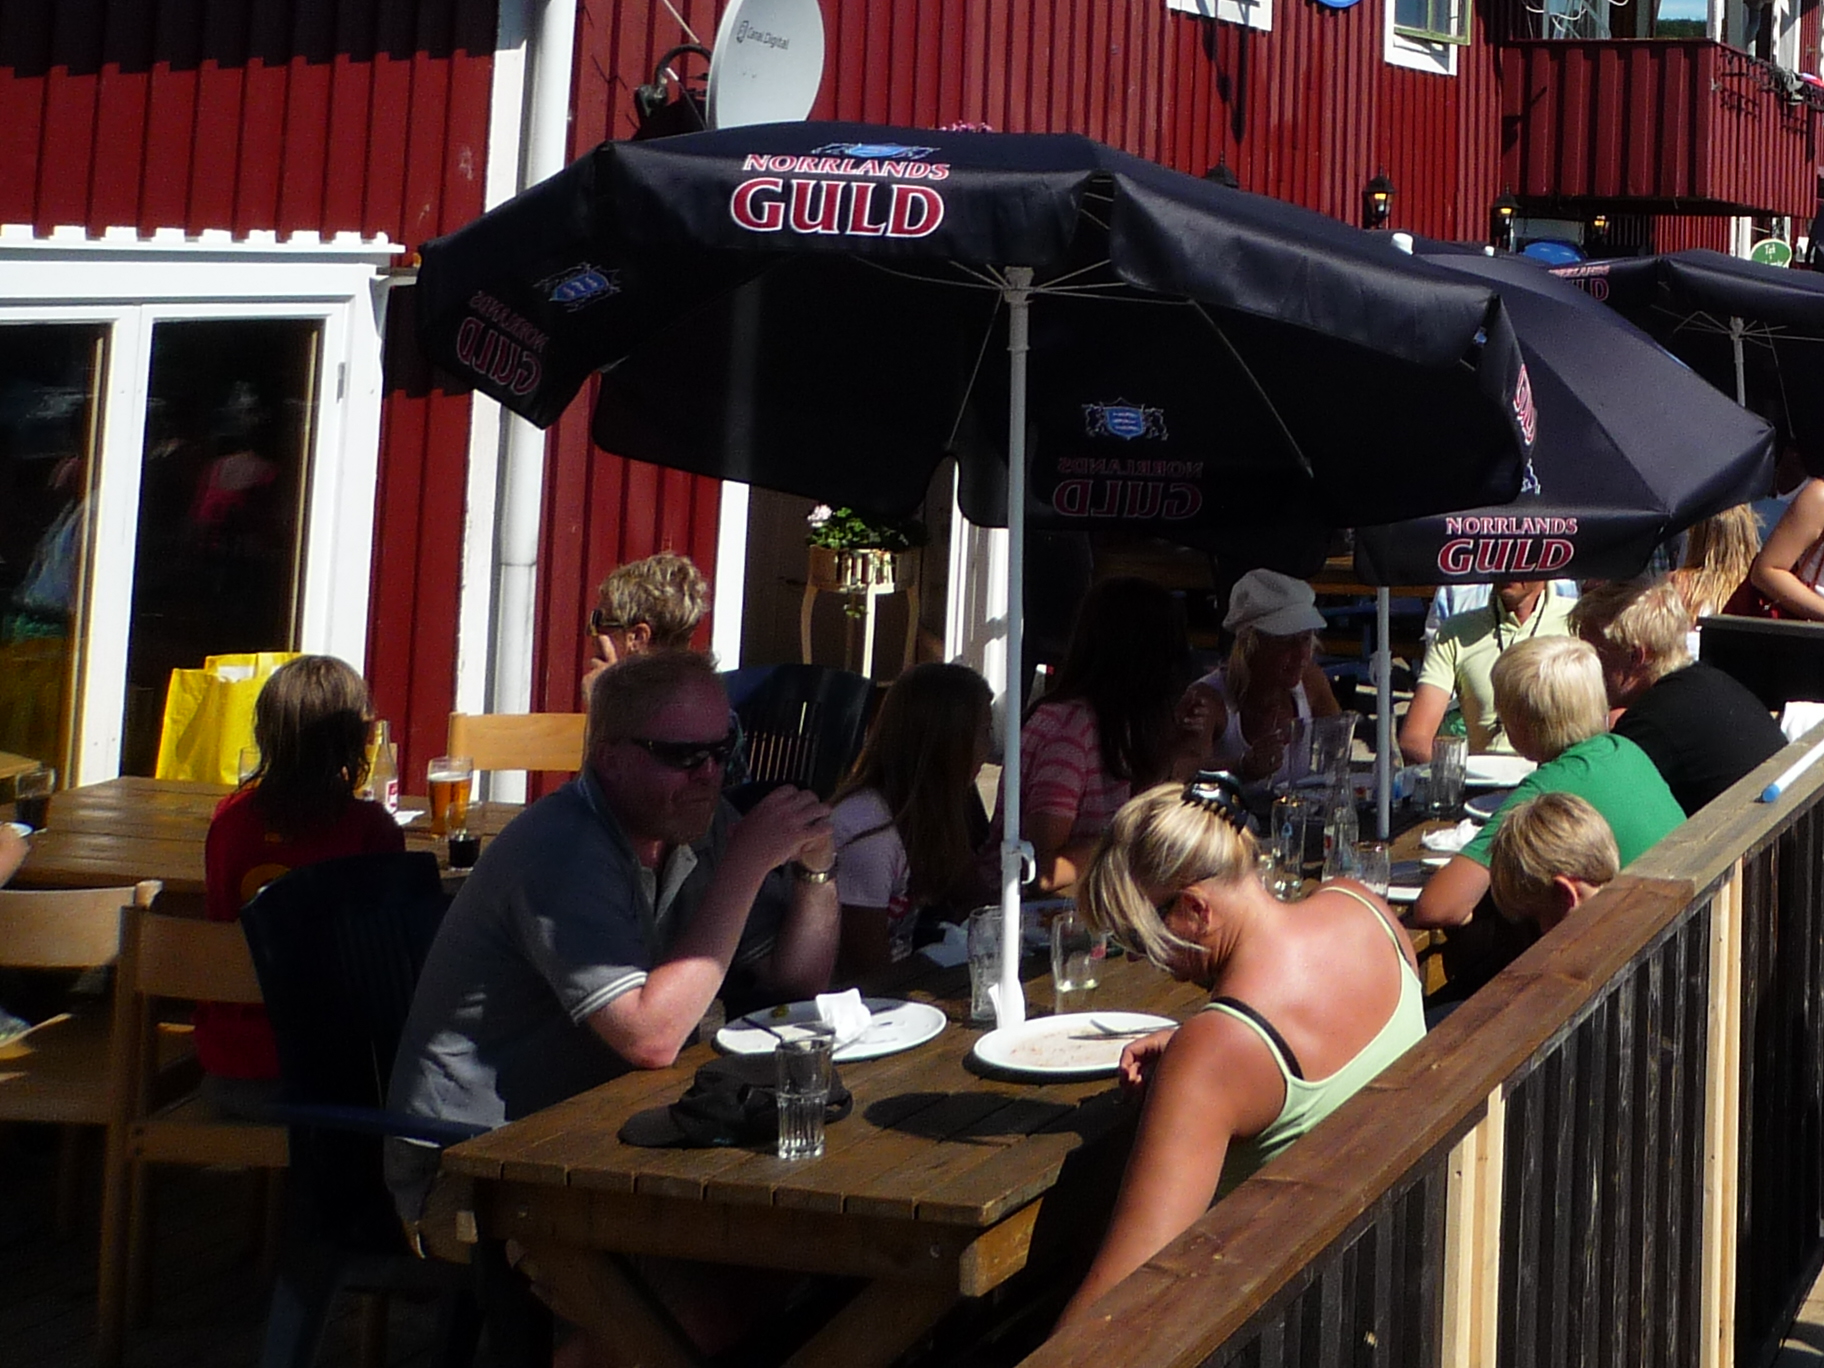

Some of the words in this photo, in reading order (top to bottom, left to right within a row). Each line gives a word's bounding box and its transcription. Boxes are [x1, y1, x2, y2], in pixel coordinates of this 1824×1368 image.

[742, 153, 951, 181] NORRLANDS
[730, 176, 945, 239] GULD
[1445, 516, 1579, 535] NORRLANDS
[1437, 538, 1575, 575] GULD
